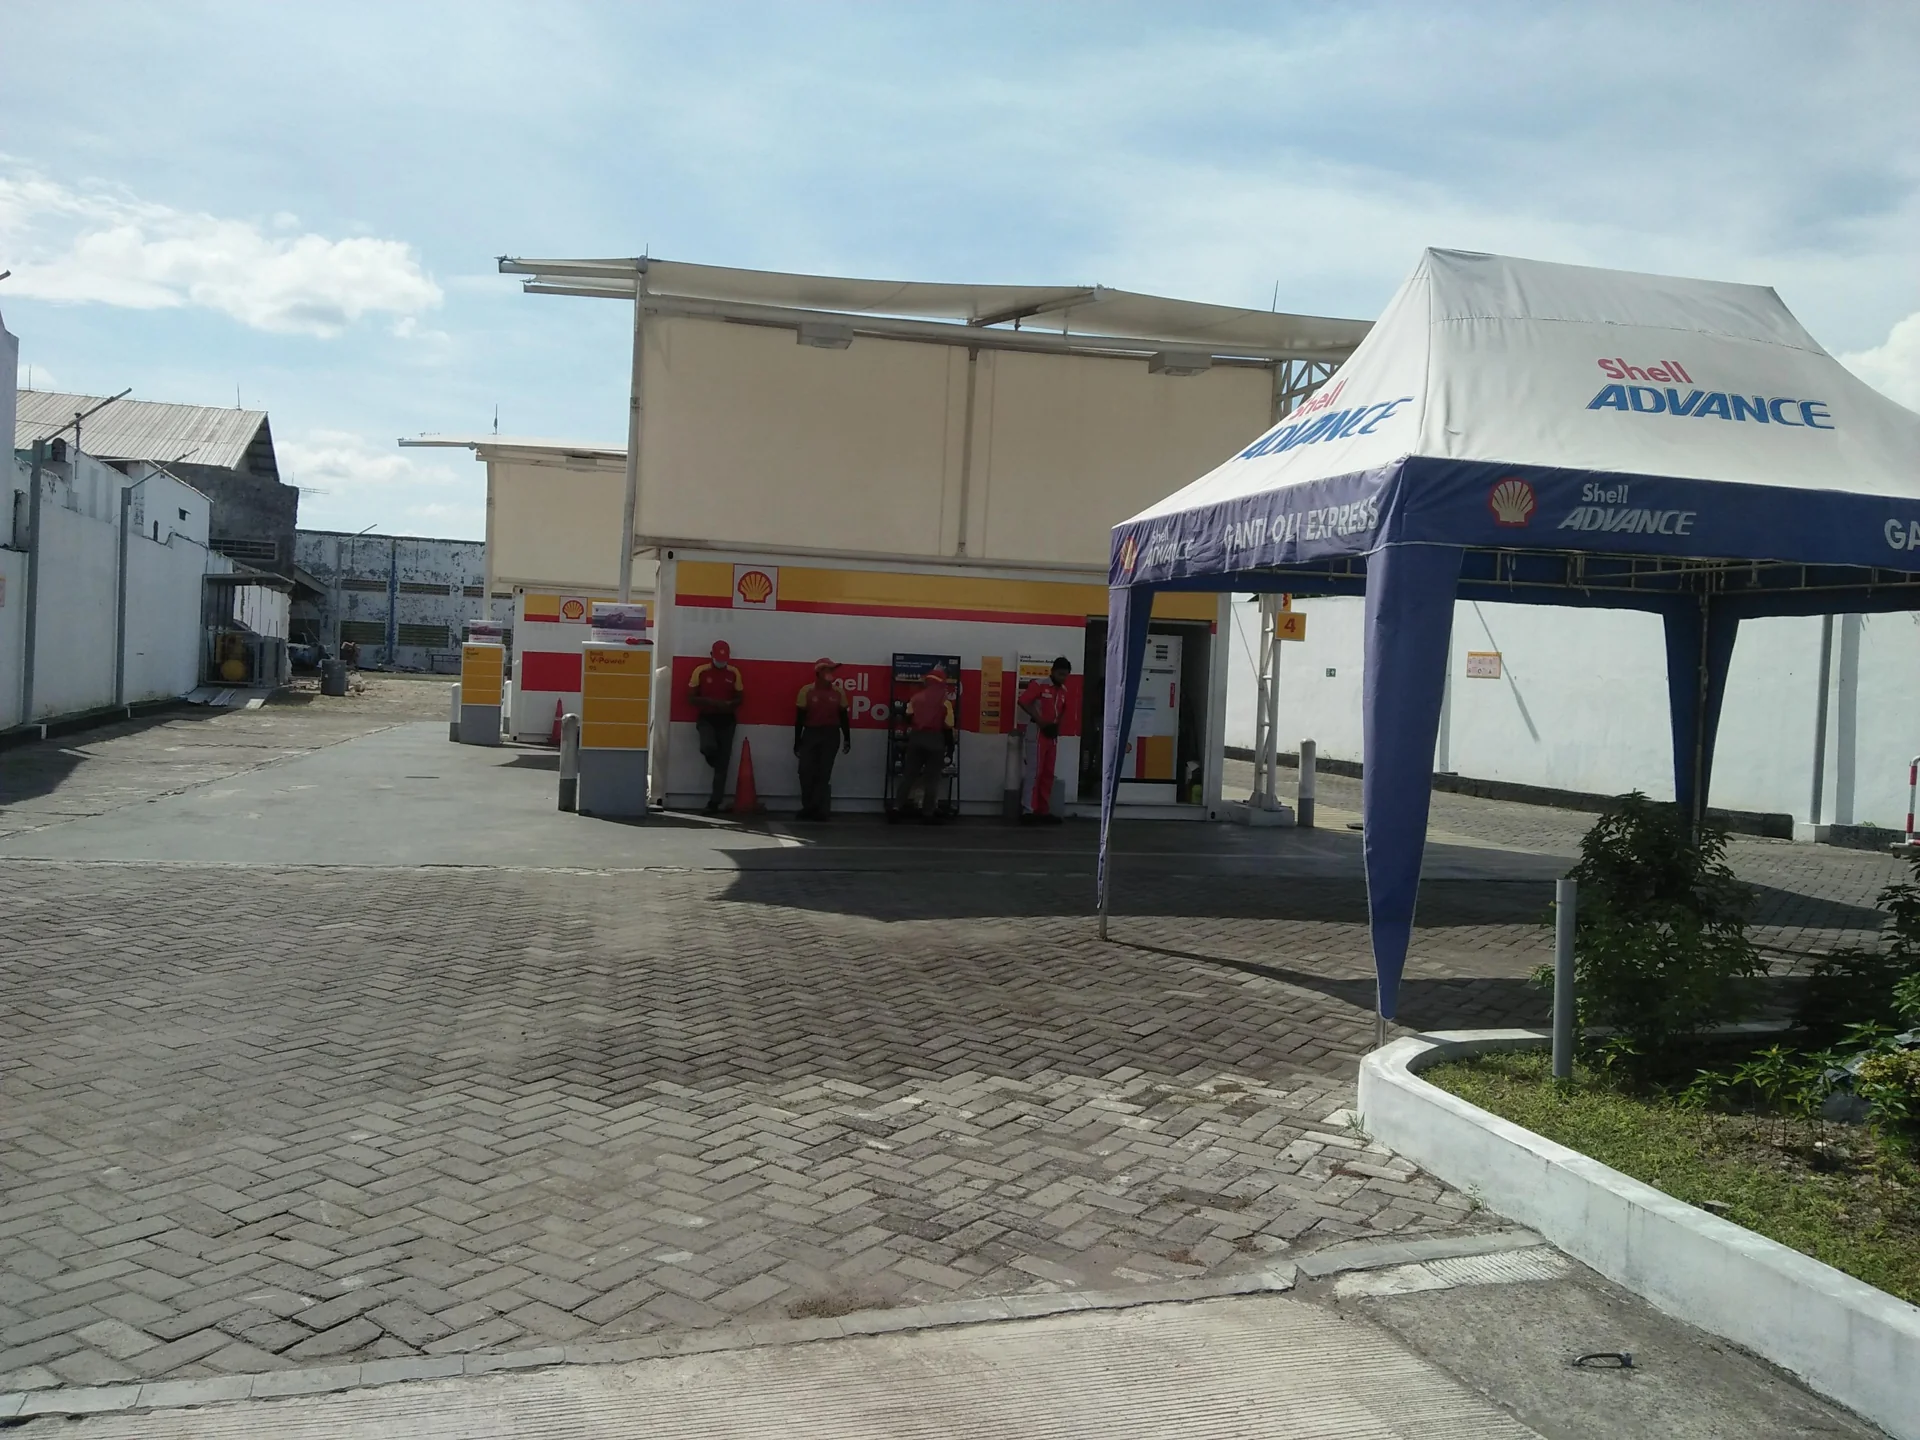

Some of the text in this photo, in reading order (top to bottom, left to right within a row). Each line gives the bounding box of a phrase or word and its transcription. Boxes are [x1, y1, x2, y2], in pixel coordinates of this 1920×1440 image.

[1597, 357, 1693, 384] Shell
[1585, 383, 1835, 430] ADVANCE
[1234, 396, 1415, 462] ADVANCE
[1582, 483, 1628, 504] Shell
[1223, 516, 1267, 551] GANTI
[1305, 495, 1379, 540] EXPRESS
[1557, 506, 1697, 535] ADVANCE
[1284, 617, 1297, 633] 4
